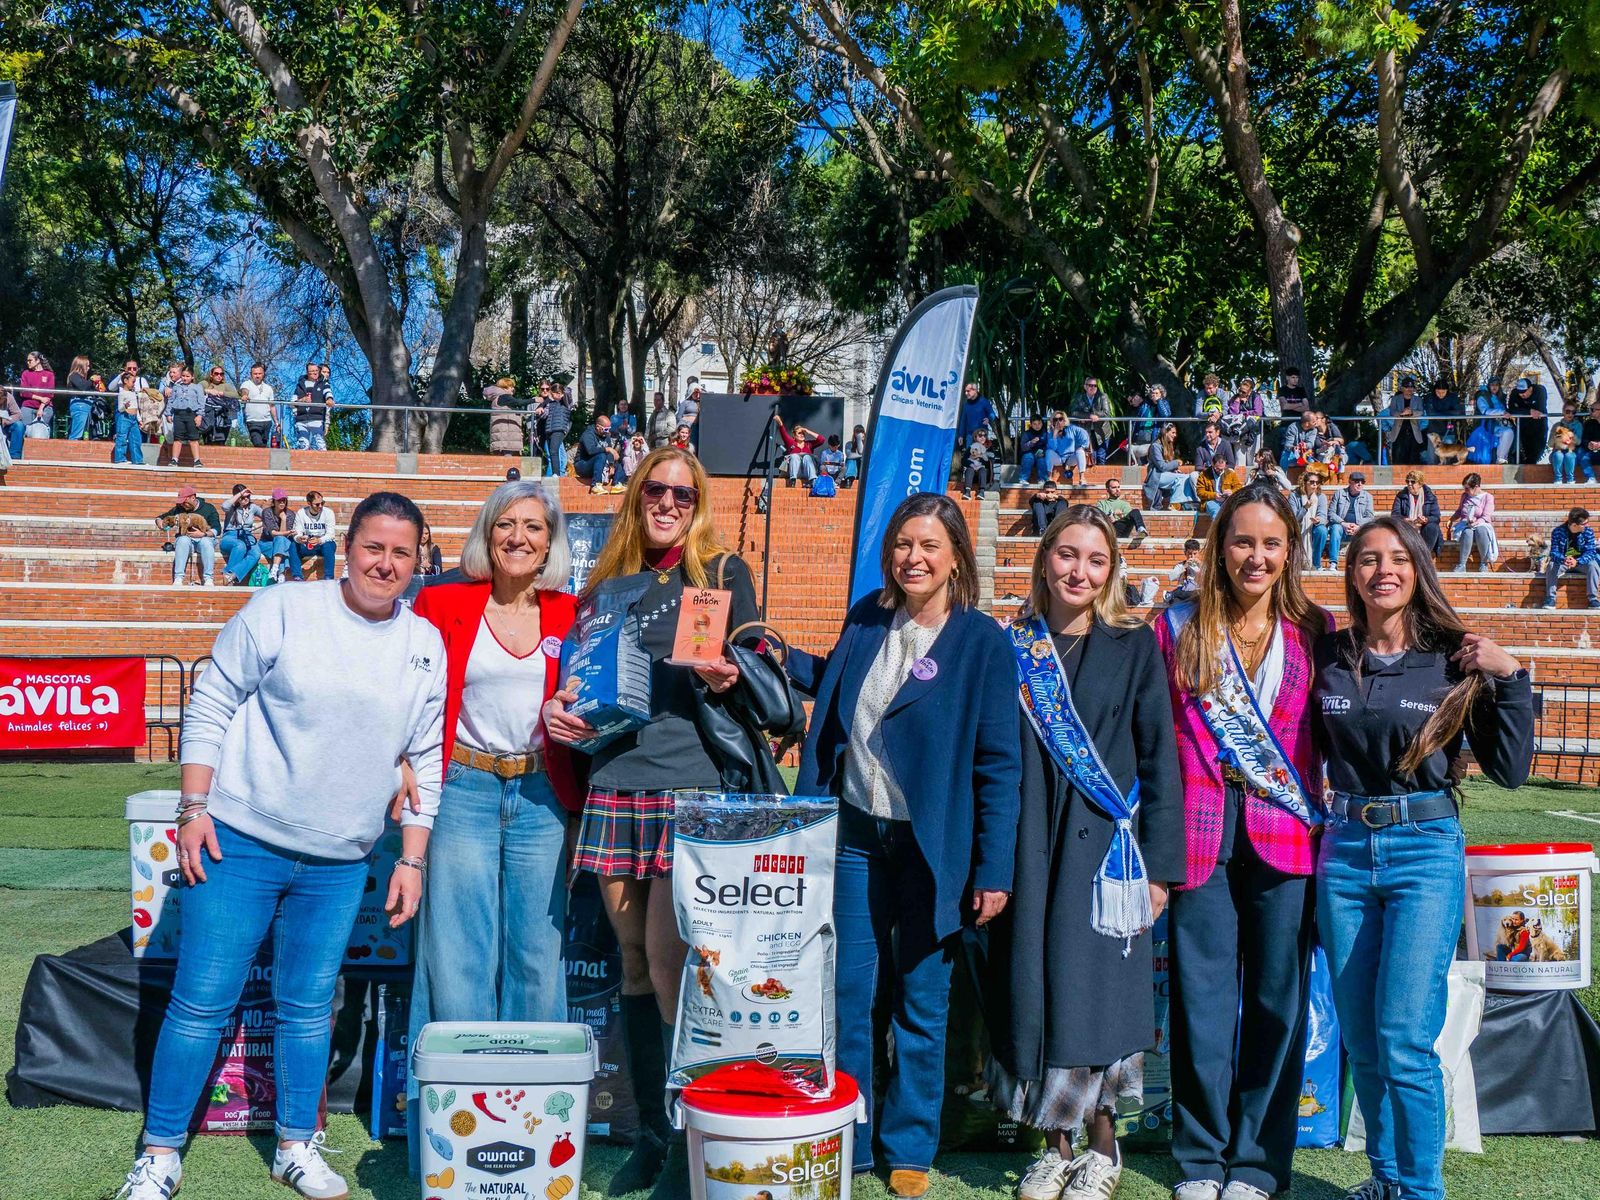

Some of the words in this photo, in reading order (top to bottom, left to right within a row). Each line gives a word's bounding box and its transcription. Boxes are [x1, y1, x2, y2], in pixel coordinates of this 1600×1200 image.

[916, 399, 944, 412] Veterina
[700, 590, 712, 598] San
[693, 596, 719, 605] Antón
[26, 675, 91, 684] MASCOTAS
[8, 720, 52, 731] Animales
[58, 720, 92, 731] felices
[754, 855, 805, 874] picart
[694, 875, 807, 907] Select
[1522, 889, 1579, 907] Select
[693, 906, 717, 914] SELECTED
[692, 919, 713, 927] ADULT
[757, 932, 802, 942] CHICKEN
[769, 941, 783, 949] and
[565, 959, 608, 978] nat
[1538, 966, 1574, 974] NATURAL
[692, 1006, 724, 1018] EXTRA
[242, 1009, 262, 1028] NO
[702, 1018, 724, 1028] CARE
[222, 1043, 274, 1057] NATURAL
[601, 1062, 619, 1071] FRESH
[224, 1111, 238, 1119] DOG
[477, 1149, 525, 1162] ownat
[771, 1151, 841, 1184] Select
[464, 1182, 477, 1193] The
[480, 1182, 526, 1194] NATURAL
